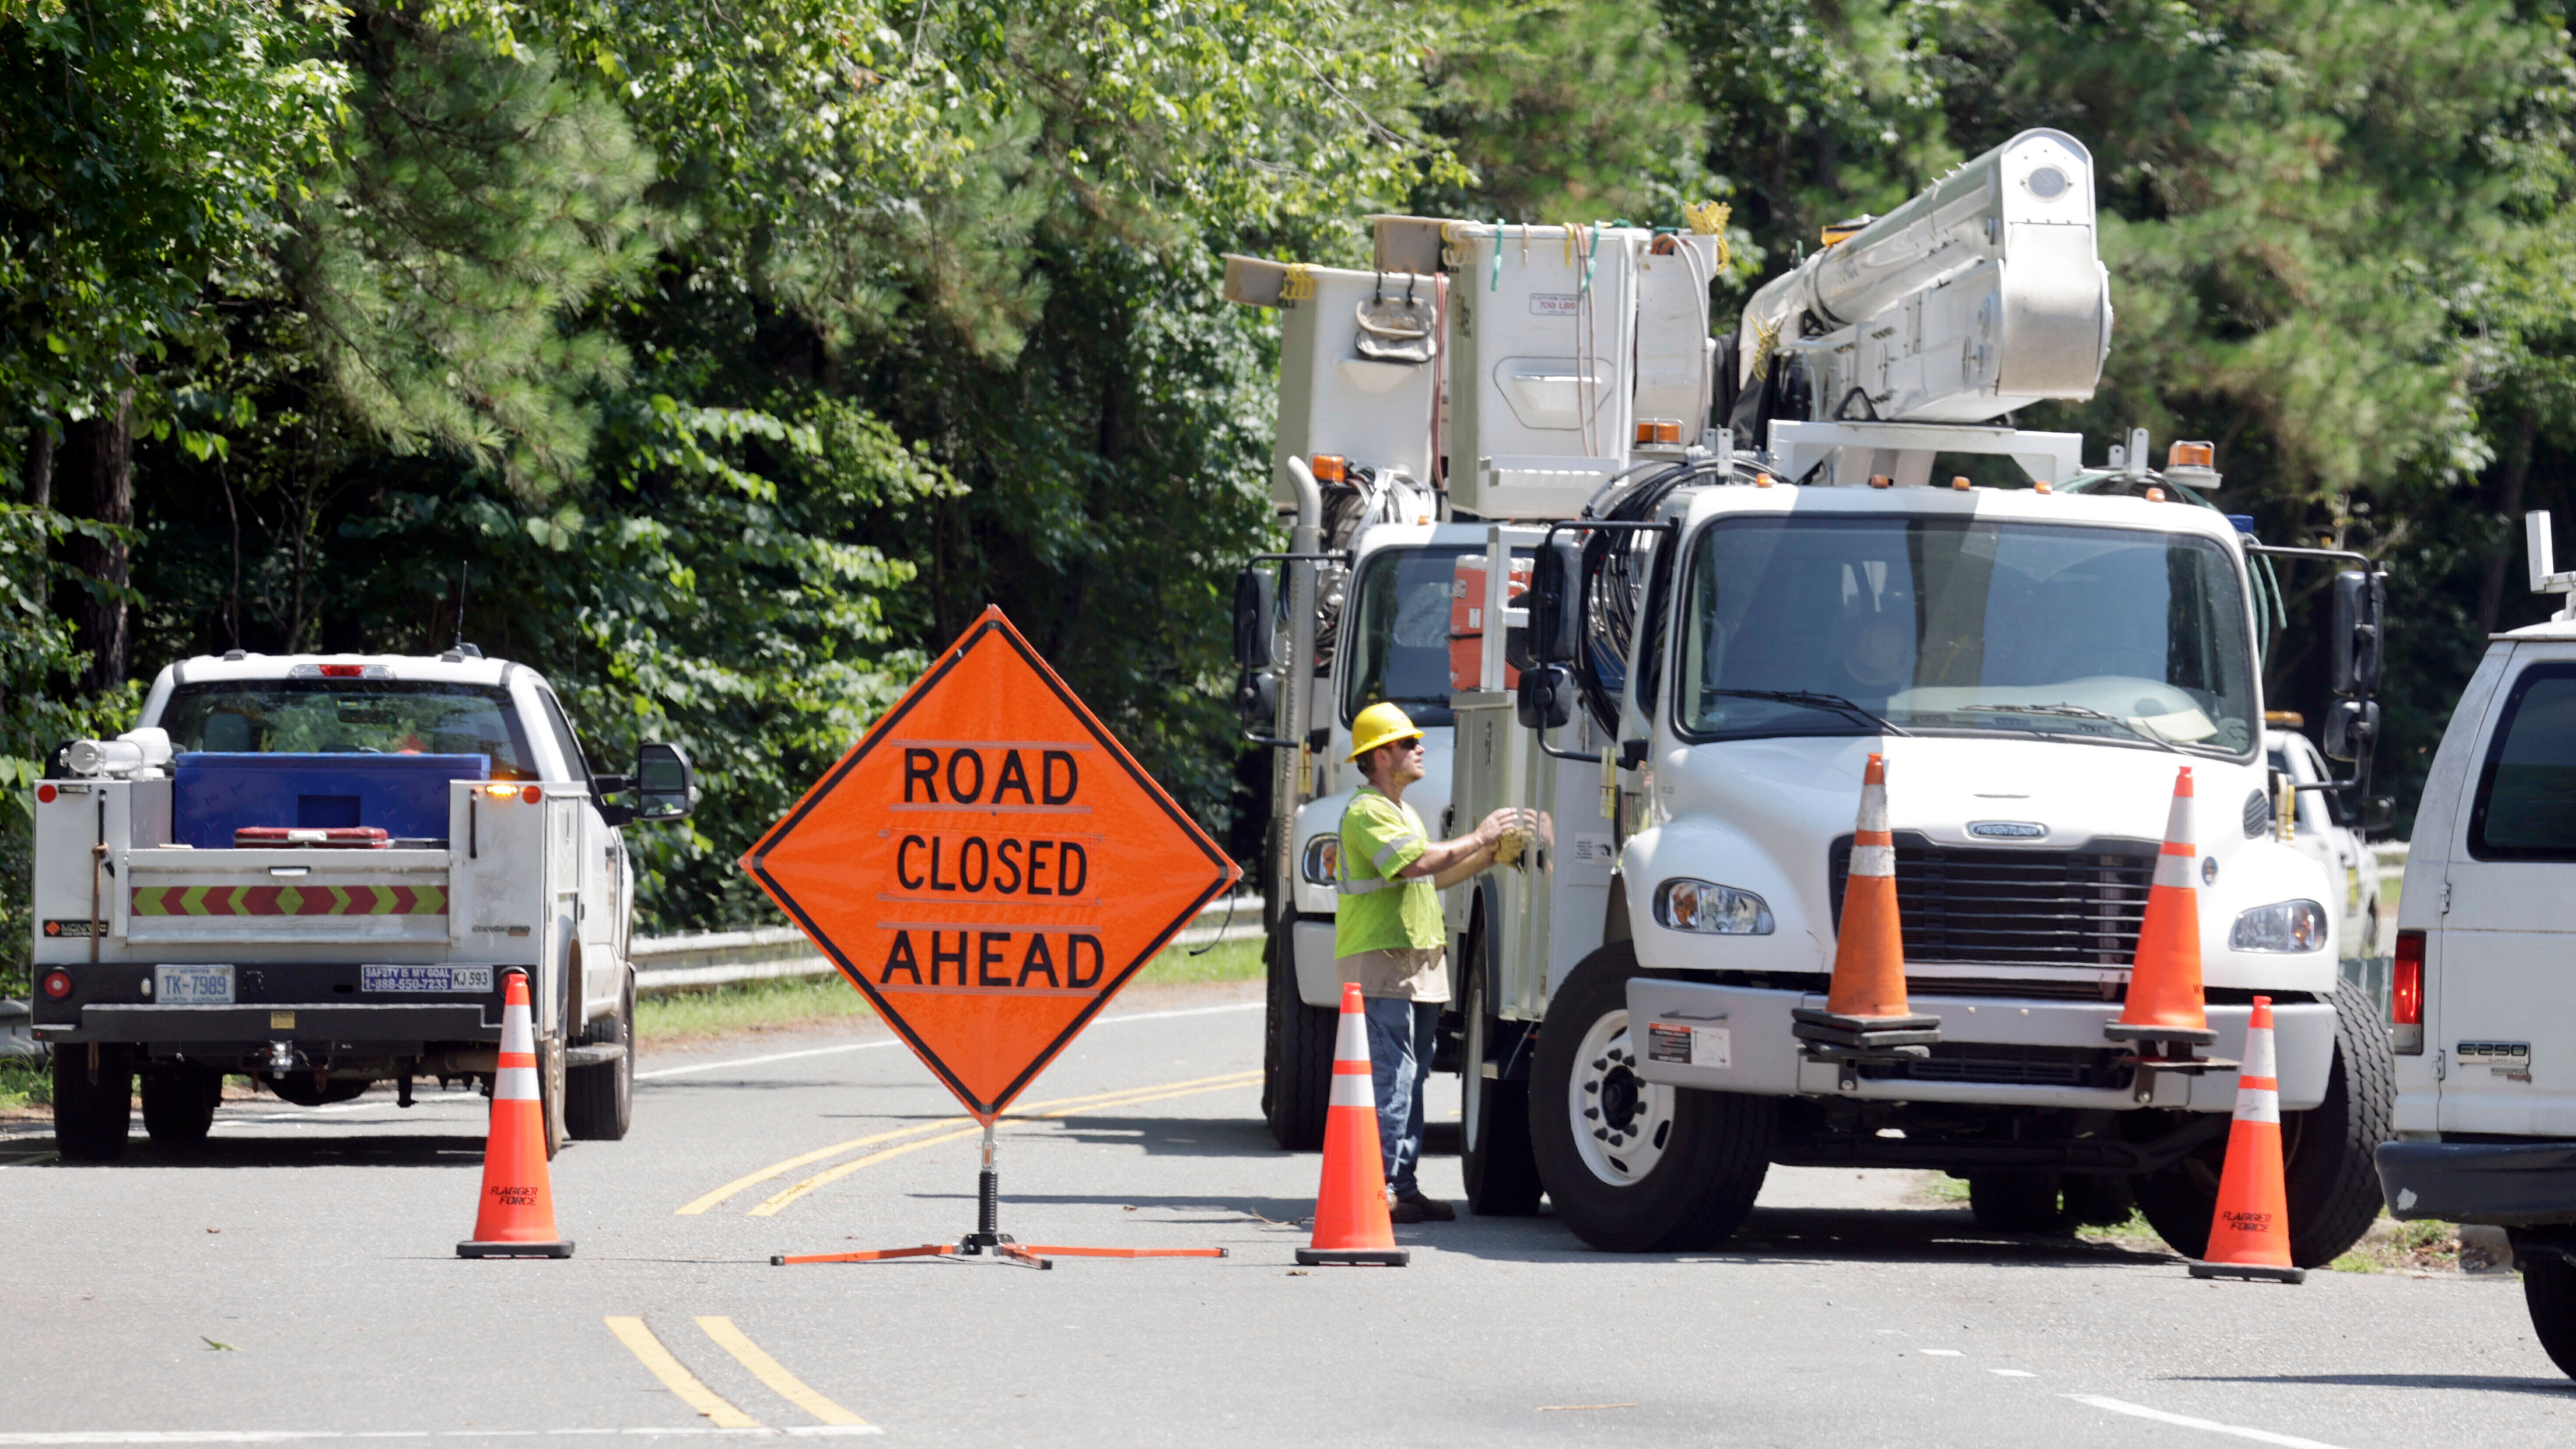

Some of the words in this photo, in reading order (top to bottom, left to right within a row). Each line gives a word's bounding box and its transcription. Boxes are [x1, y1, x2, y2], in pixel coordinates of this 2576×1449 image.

[904, 748, 1078, 805] ROAD
[897, 834, 1087, 896] CLOSED
[880, 930, 1104, 988] AHEAD
[365, 967, 399, 978] SAFETY
[401, 968, 409, 978] IS
[412, 968, 427, 978] MY
[426, 968, 450, 978] GOAL
[454, 971, 466, 985] KJ
[468, 971, 488, 985] 593
[165, 976, 226, 995] TK-7989
[490, 1186, 538, 1196] FLAGGER
[500, 1196, 537, 1206] FORCE
